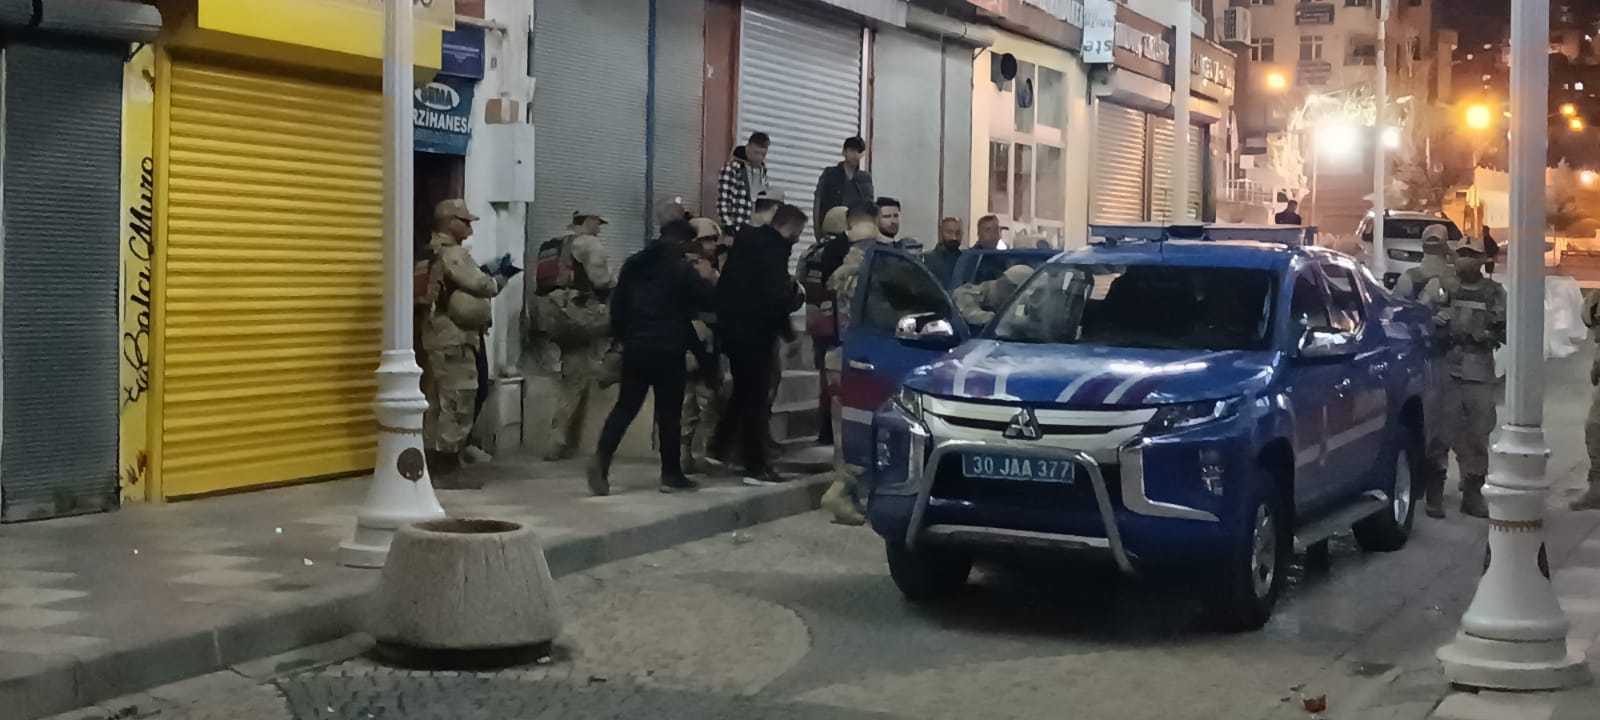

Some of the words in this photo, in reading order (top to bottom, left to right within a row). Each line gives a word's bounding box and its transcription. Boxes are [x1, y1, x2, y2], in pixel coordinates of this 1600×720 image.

[412, 108, 472, 134] RZİHANESİ
[973, 456, 994, 475] 30
[999, 458, 1033, 477] JAA
[1037, 460, 1071, 478] 377
